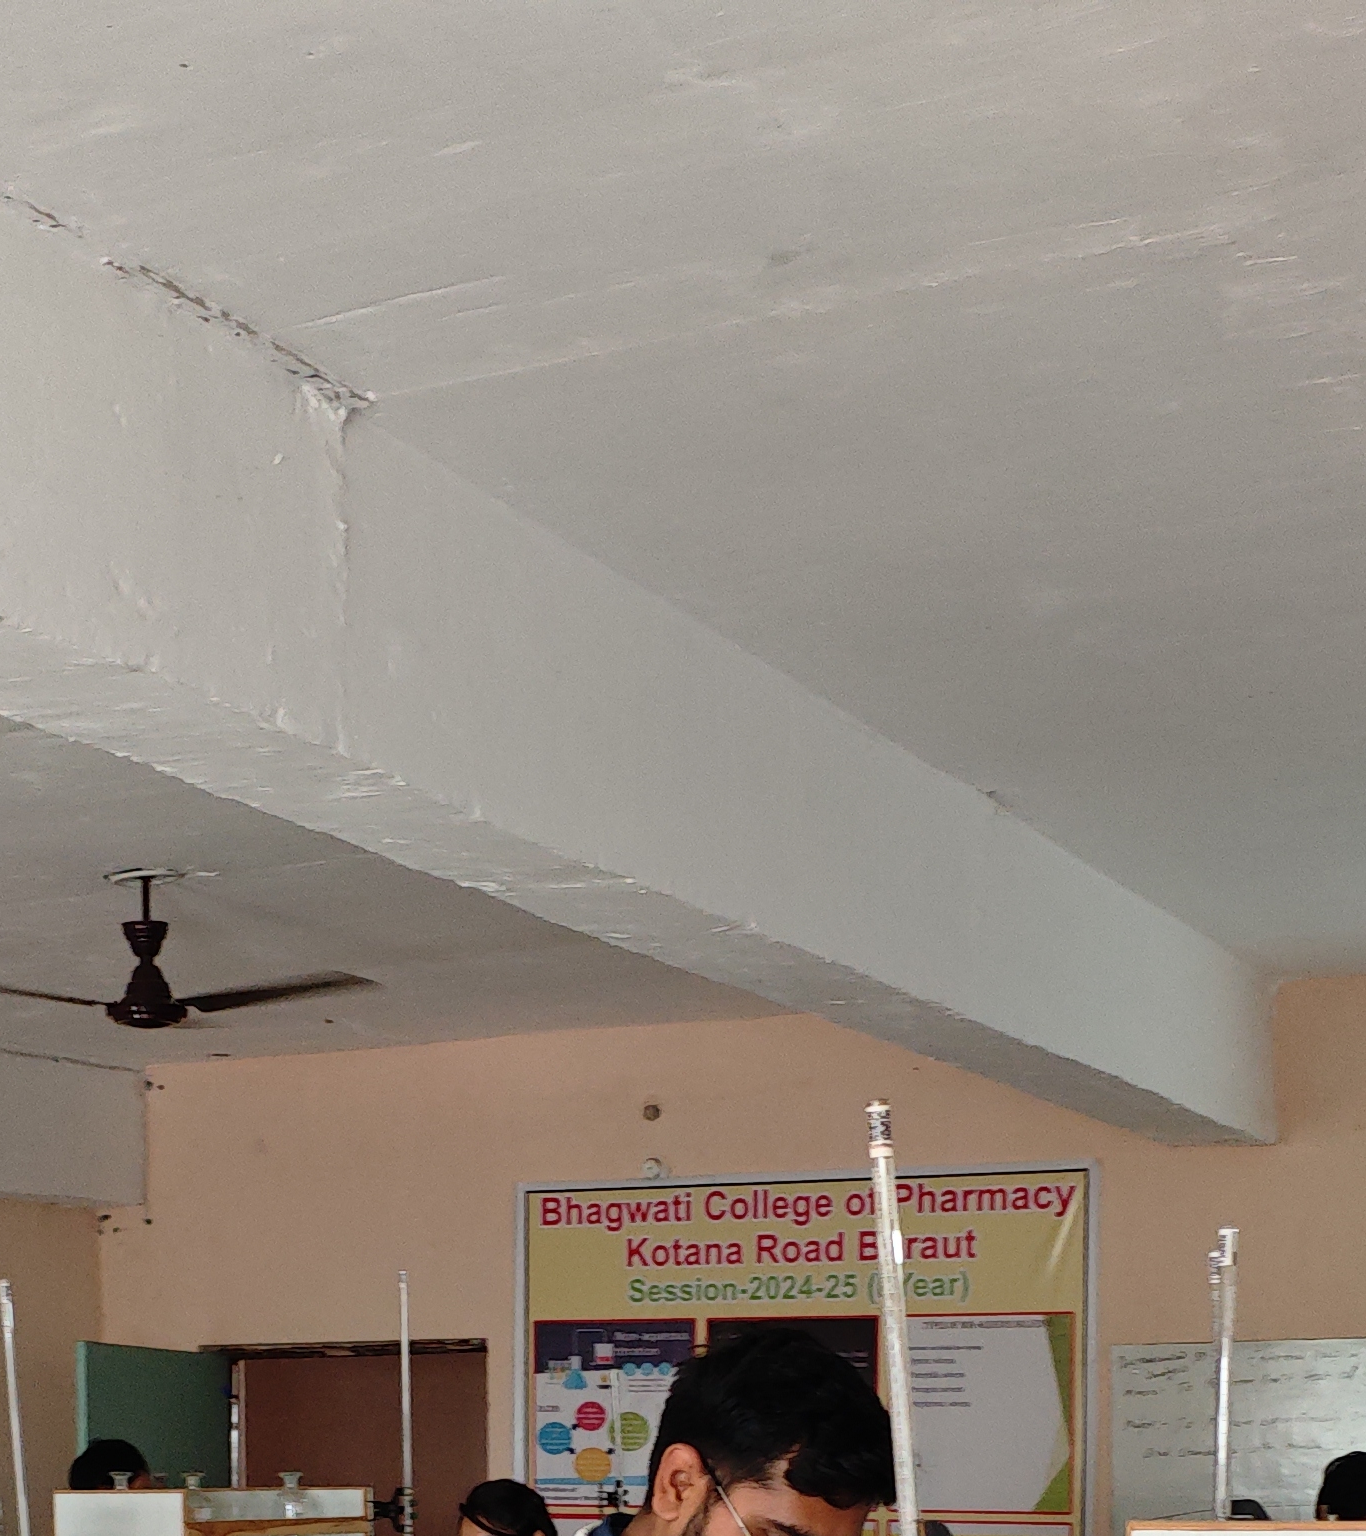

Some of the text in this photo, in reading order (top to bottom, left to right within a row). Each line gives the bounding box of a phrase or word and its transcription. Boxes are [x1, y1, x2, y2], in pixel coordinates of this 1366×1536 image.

[539, 1191, 693, 1232] Bhagwati
[703, 1188, 833, 1227] College
[895, 1182, 1077, 1218] Pharmacy
[625, 1228, 978, 1268] Kotana Road Braut
[627, 1272, 858, 1303] Session-2024-25
